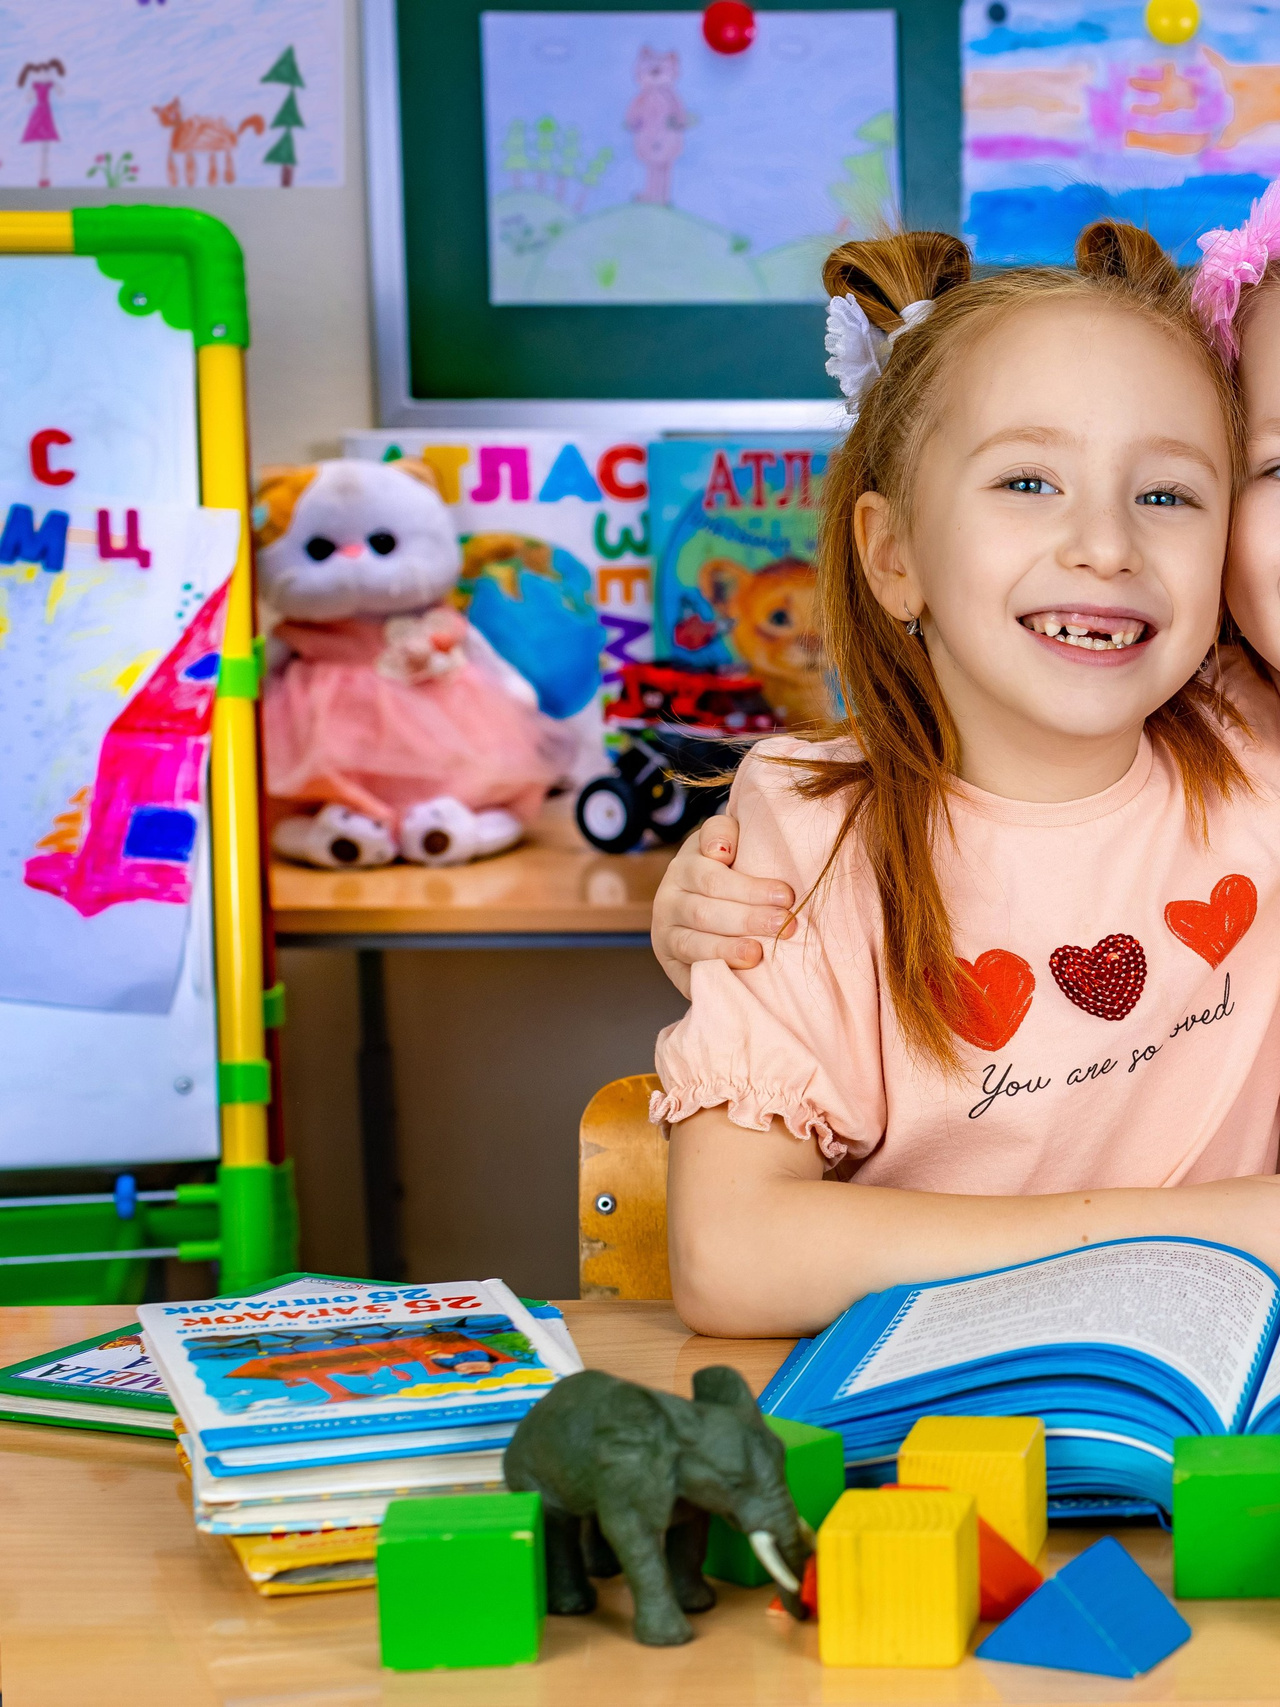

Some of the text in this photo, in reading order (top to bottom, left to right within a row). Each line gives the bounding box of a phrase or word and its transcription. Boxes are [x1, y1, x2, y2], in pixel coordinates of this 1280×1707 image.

[29, 427, 76, 487] С
[379, 442, 647, 503] ТЛАС
[703, 449, 832, 511] АТЛ
[968, 1062, 1052, 1120] You
[1066, 1057, 1119, 1086] are
[1128, 1043, 1164, 1073] so
[178, 1295, 483, 1327] 25 ЗАГАДОК
[367, 1287, 432, 1304] 25
[175, 1321, 299, 1335] ЧУКОВСКИЙ
[37, 1363, 168, 1392] МЕНА
